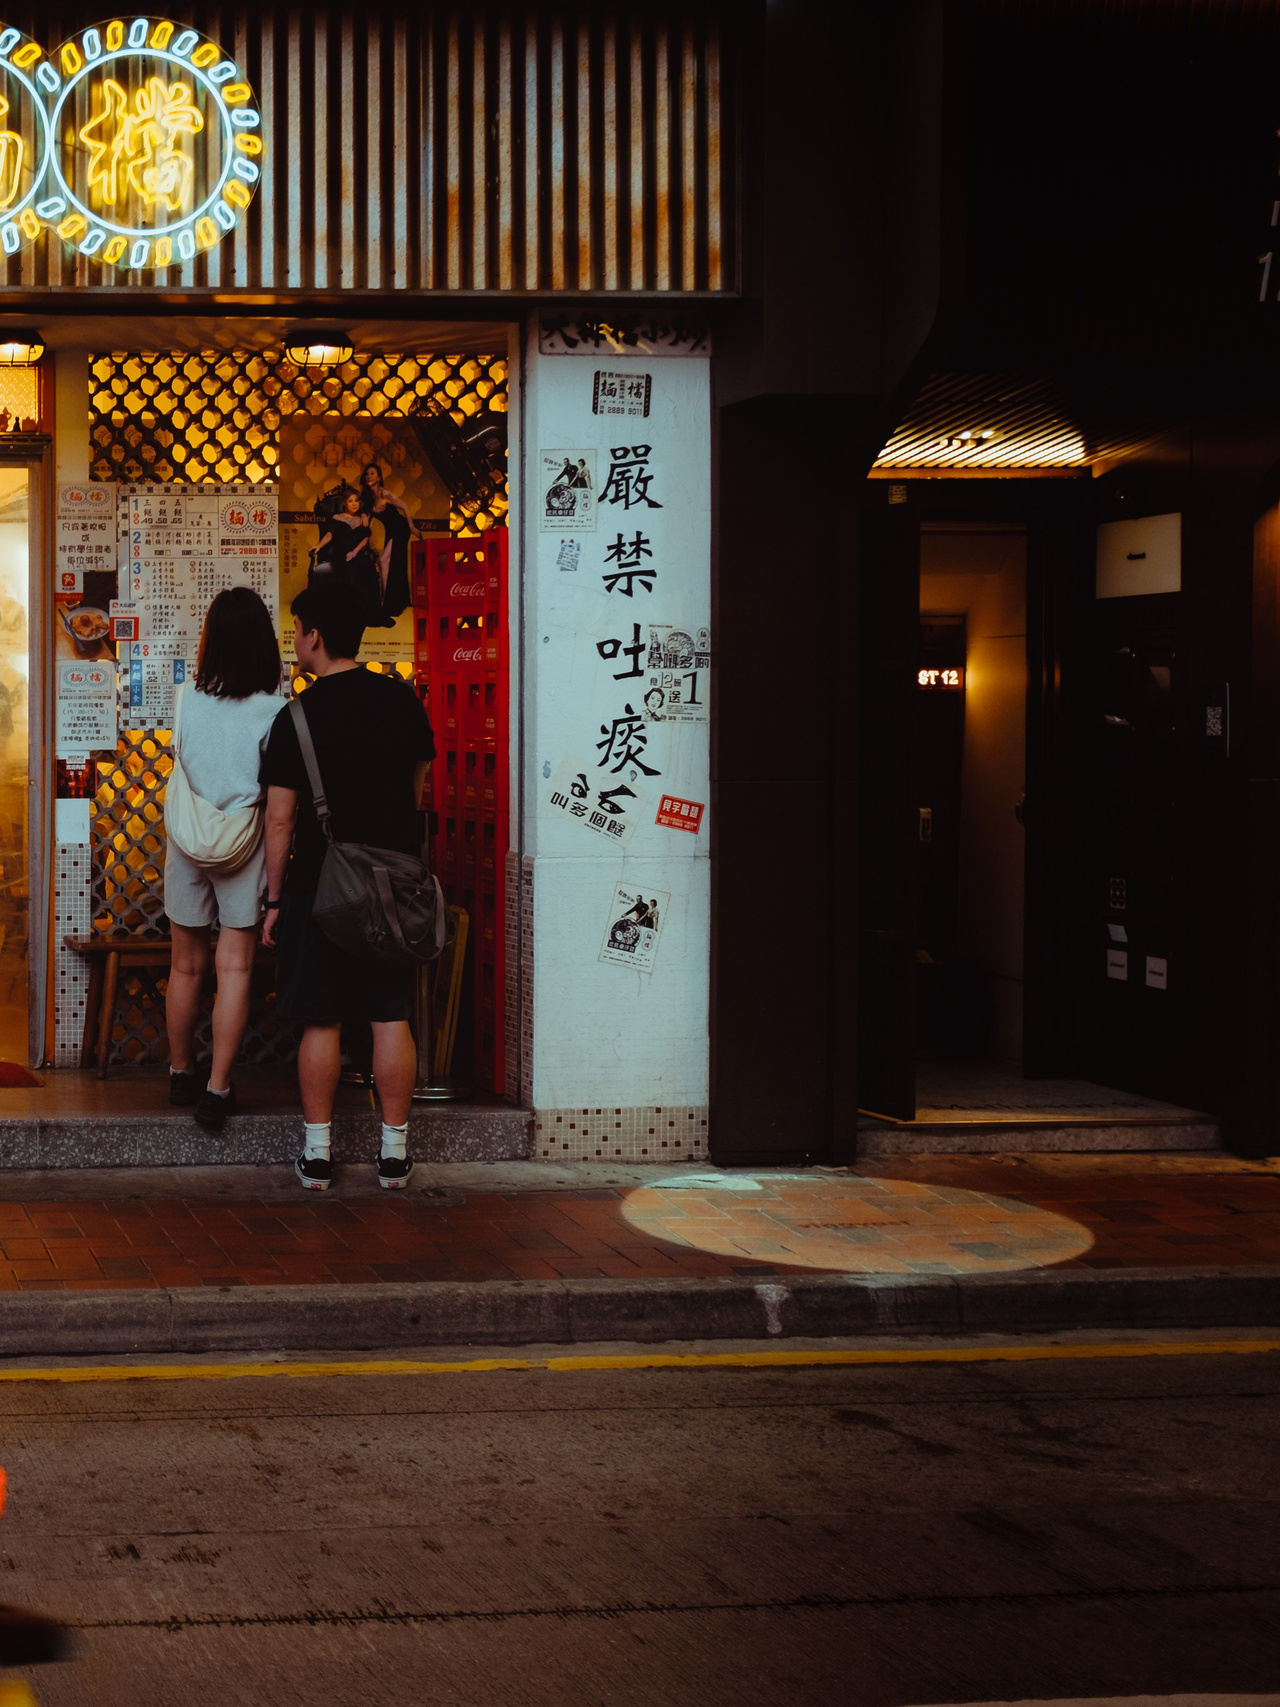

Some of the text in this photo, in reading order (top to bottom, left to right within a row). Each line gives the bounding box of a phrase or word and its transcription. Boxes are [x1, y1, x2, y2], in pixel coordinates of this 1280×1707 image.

[607, 407, 625, 415] 2889
[628, 408, 643, 416] 9011
[132, 498, 139, 511] 1
[294, 513, 327, 523] Sabrina
[420, 521, 437, 530] Zita
[132, 531, 142, 545] 2
[259, 547, 277, 555] 9011
[132, 561, 142, 575] 3
[596, 444, 664, 777] 嚴禁吐痰
[132, 643, 141, 657] 4
[941, 669, 959, 686] 12
[550, 791, 626, 838] 叫多個餸
